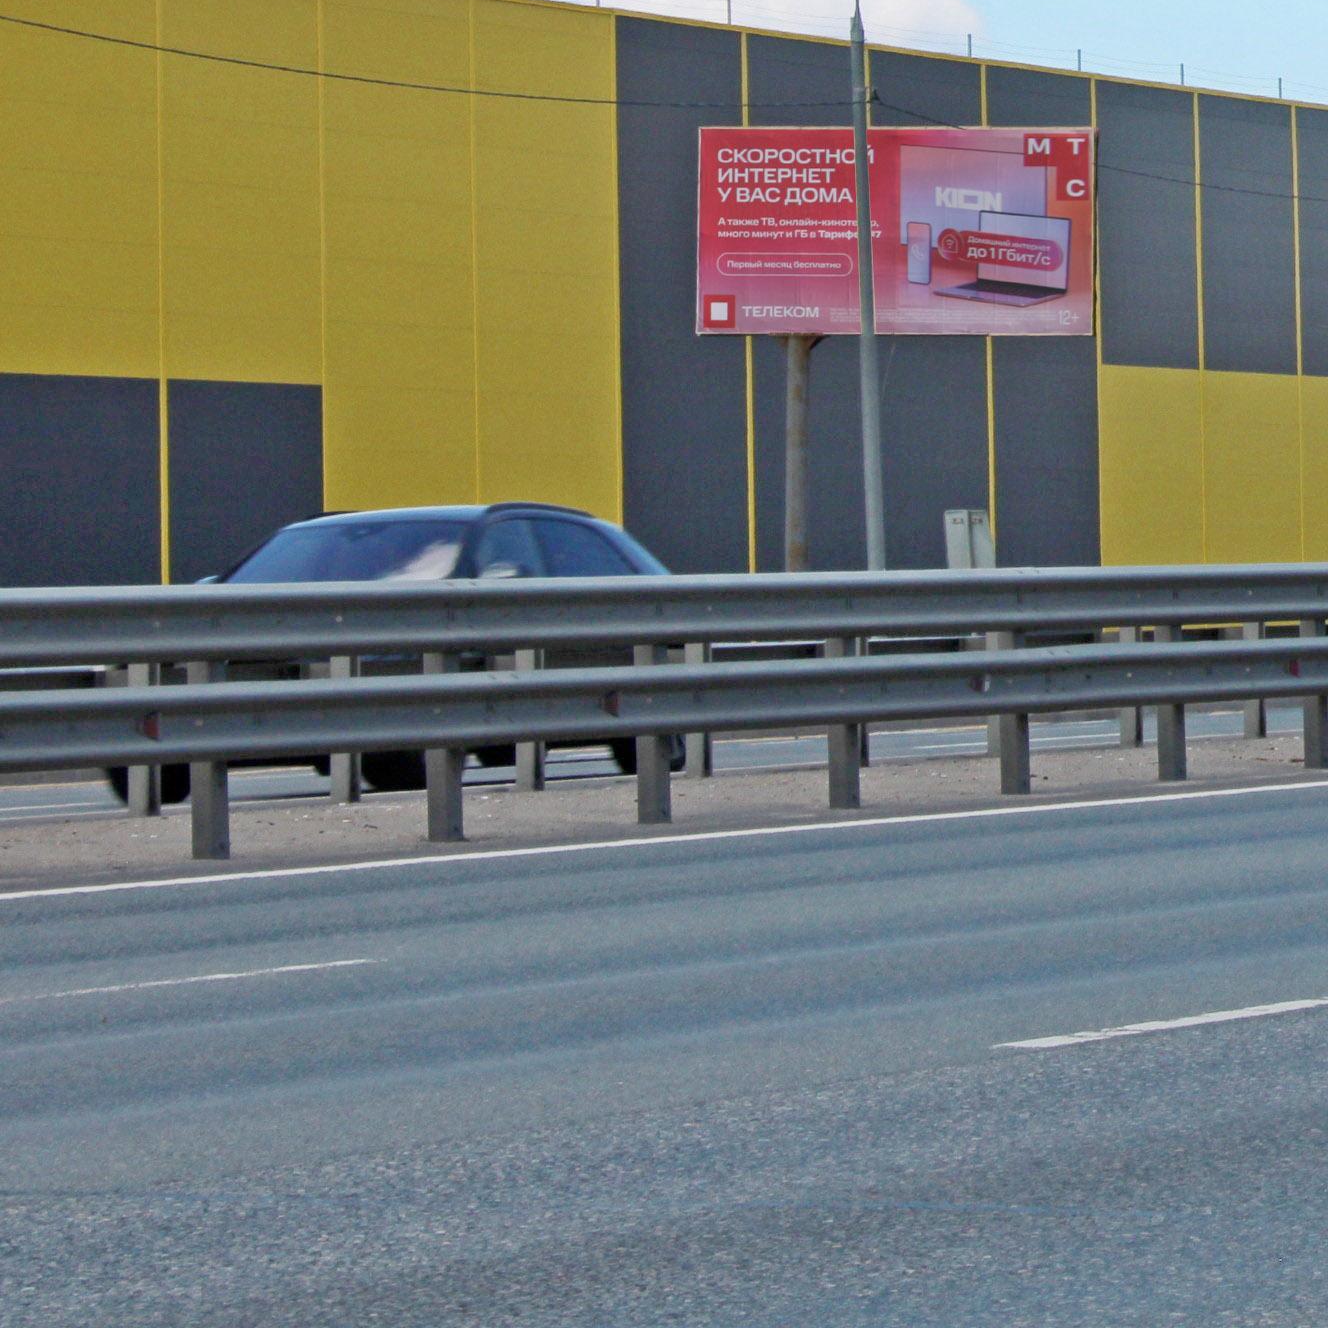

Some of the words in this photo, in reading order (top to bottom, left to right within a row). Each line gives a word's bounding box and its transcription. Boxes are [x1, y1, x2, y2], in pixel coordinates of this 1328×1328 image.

[718, 168, 835, 183] ИНТЕРНЕТ
[717, 187, 732, 202] У
[736, 187, 781, 203] ВАС
[784, 187, 853, 205] ДОМА
[935, 186, 1002, 211] KION
[718, 217, 726, 226] А
[761, 217, 778, 227] ТВ,
[751, 231, 783, 239] минут
[795, 229, 808, 238] ГБ
[967, 236, 1011, 246] Домашний
[1012, 241, 1051, 252] интернет
[967, 247, 987, 258] до
[998, 248, 1051, 265] Гбит/с
[727, 260, 763, 269] Первый
[764, 262, 792, 270] месяц
[794, 260, 841, 269] бесплатно
[742, 306, 820, 318] ТЕЛЕКОМ
[1058, 310, 1080, 325] 12+
